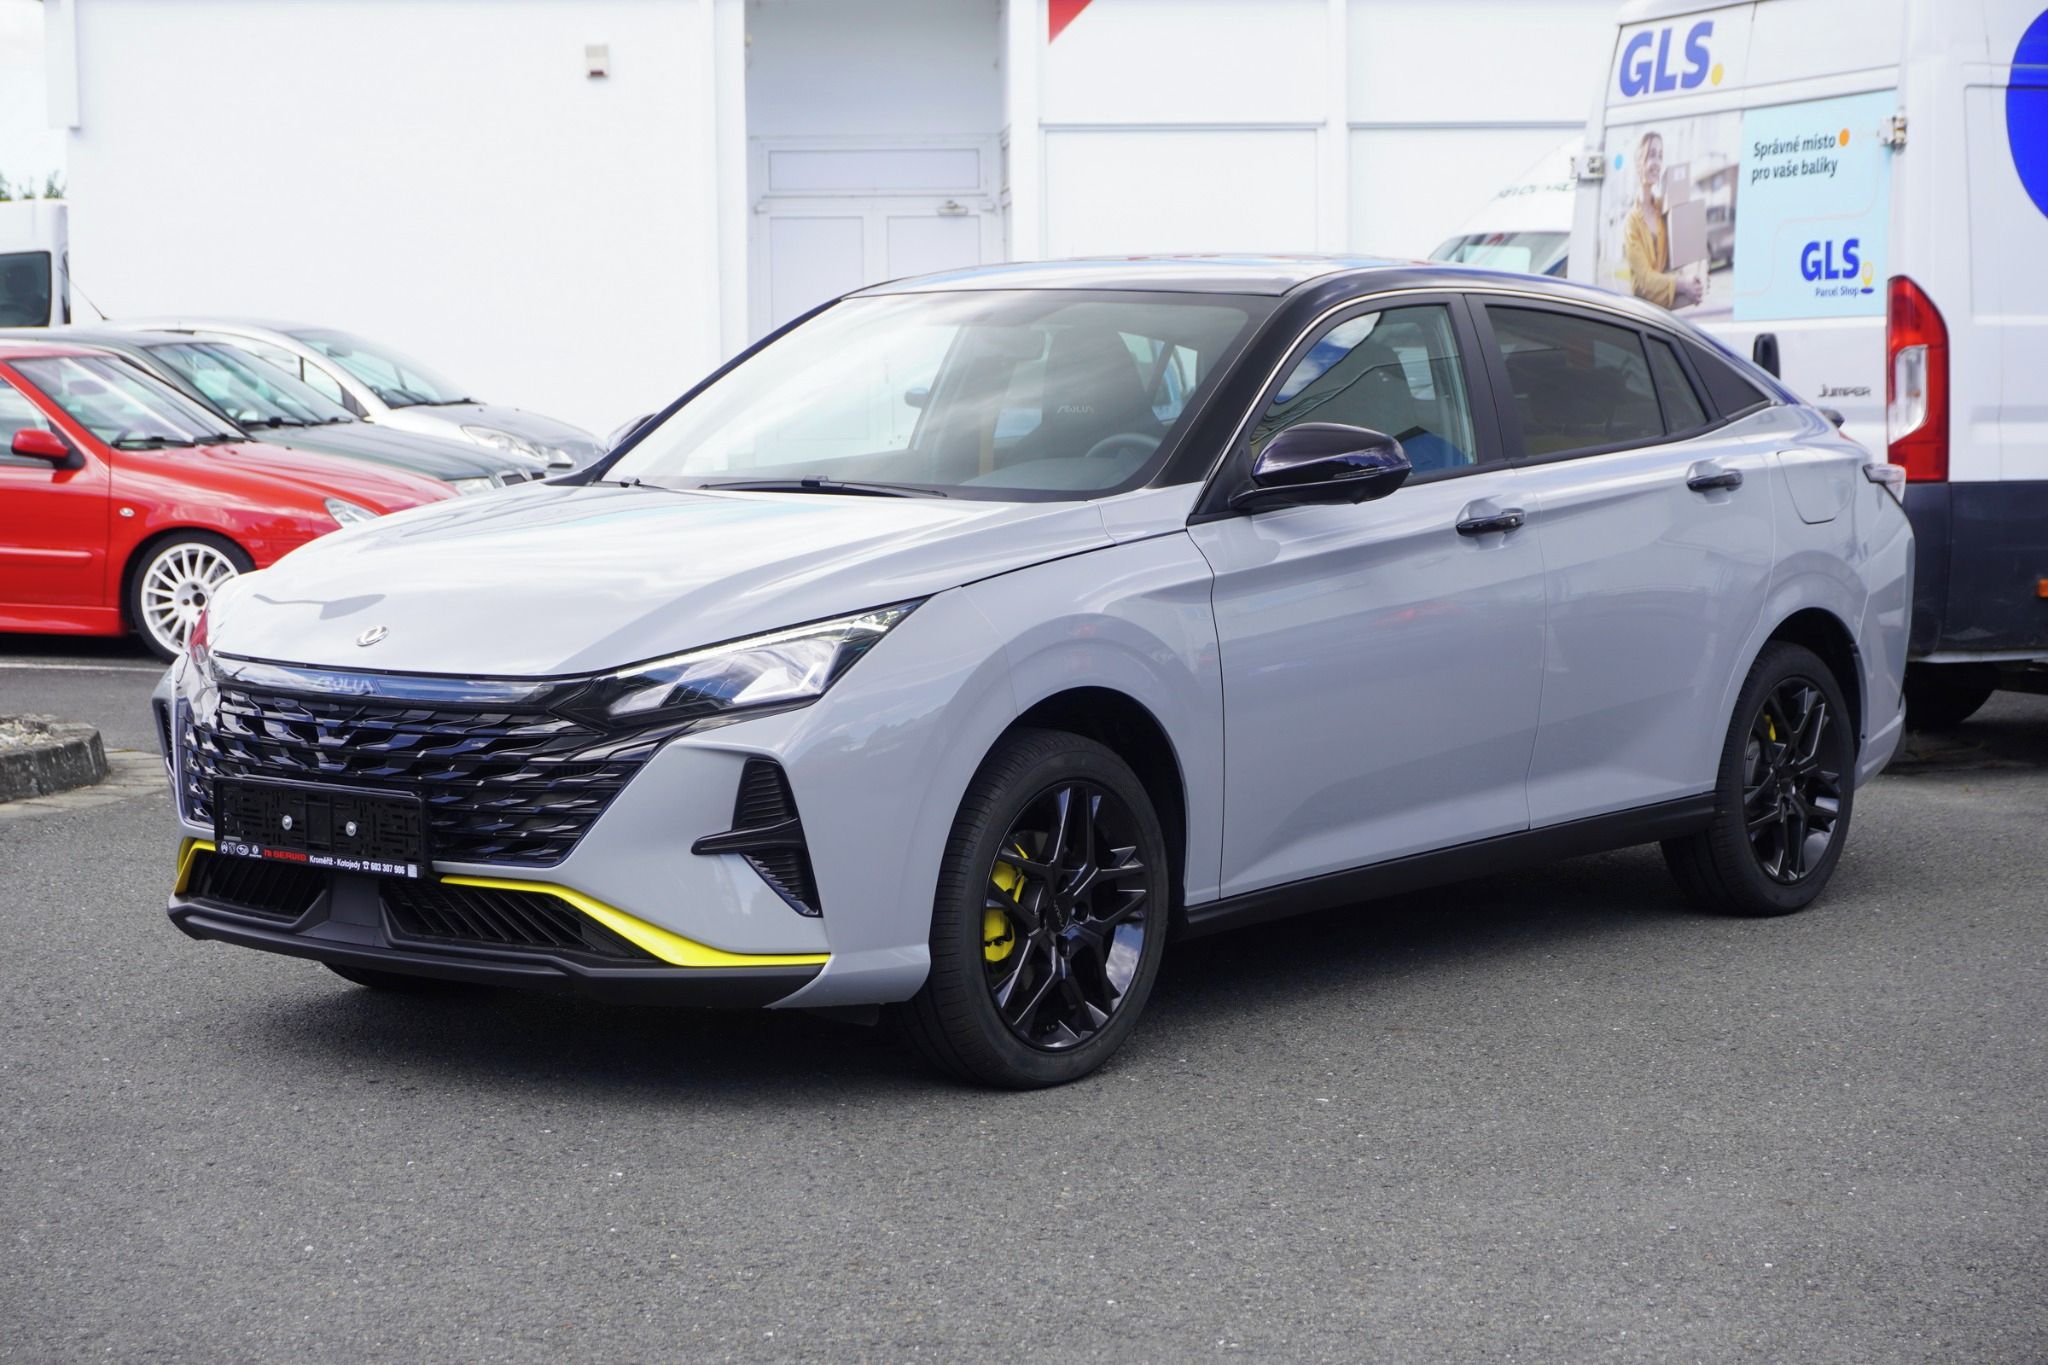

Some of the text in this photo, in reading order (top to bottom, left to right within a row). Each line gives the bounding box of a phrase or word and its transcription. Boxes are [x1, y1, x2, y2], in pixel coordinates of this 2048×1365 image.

[1753, 134, 1836, 161] Správné místo
[1751, 157, 1838, 186] pro vaše balíky
[1800, 238, 1860, 281] GLS
[1815, 285, 1859, 299] Parcel Shop
